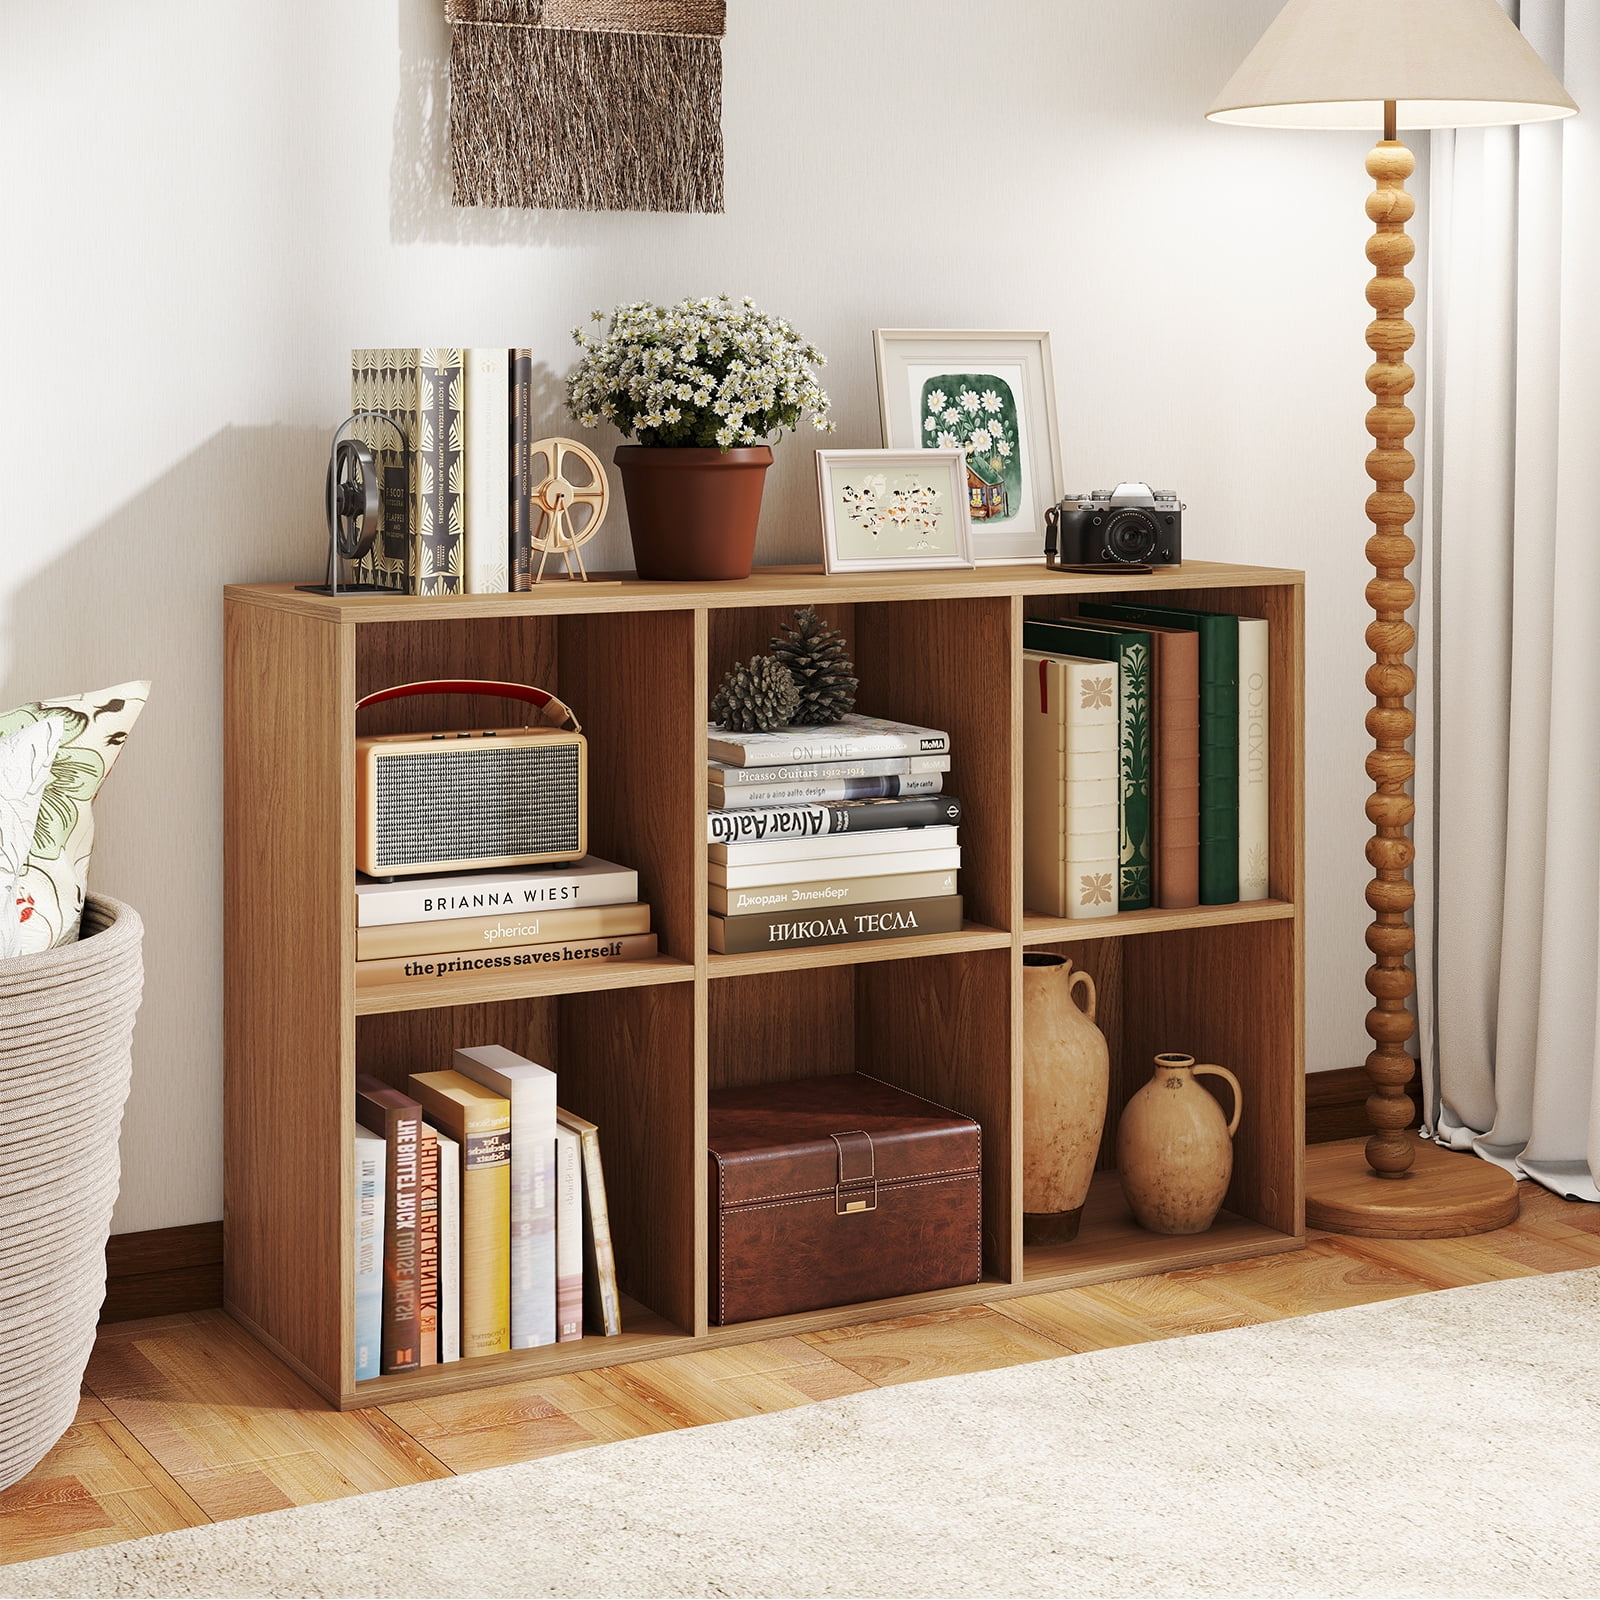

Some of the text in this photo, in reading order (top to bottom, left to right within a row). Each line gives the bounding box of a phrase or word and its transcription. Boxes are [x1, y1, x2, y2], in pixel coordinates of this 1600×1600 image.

[1248, 672, 1264, 785] LUXDECO
[792, 746, 815, 760] ON
[820, 743, 853, 758] LINE
[921, 740, 944, 750] MoMA
[738, 768, 776, 782] Picasso
[778, 766, 818, 780] Guitars
[805, 787, 826, 797] design
[712, 814, 768, 841] Aalto
[770, 810, 823, 836] Alvar
[424, 886, 581, 912] BRIANNA WIEST
[736, 886, 849, 909] Джордан Элленберг
[483, 920, 539, 943] spherical
[768, 911, 919, 942] НИКОЛА ТЕСЛА
[404, 941, 622, 976] the princess saves herself
